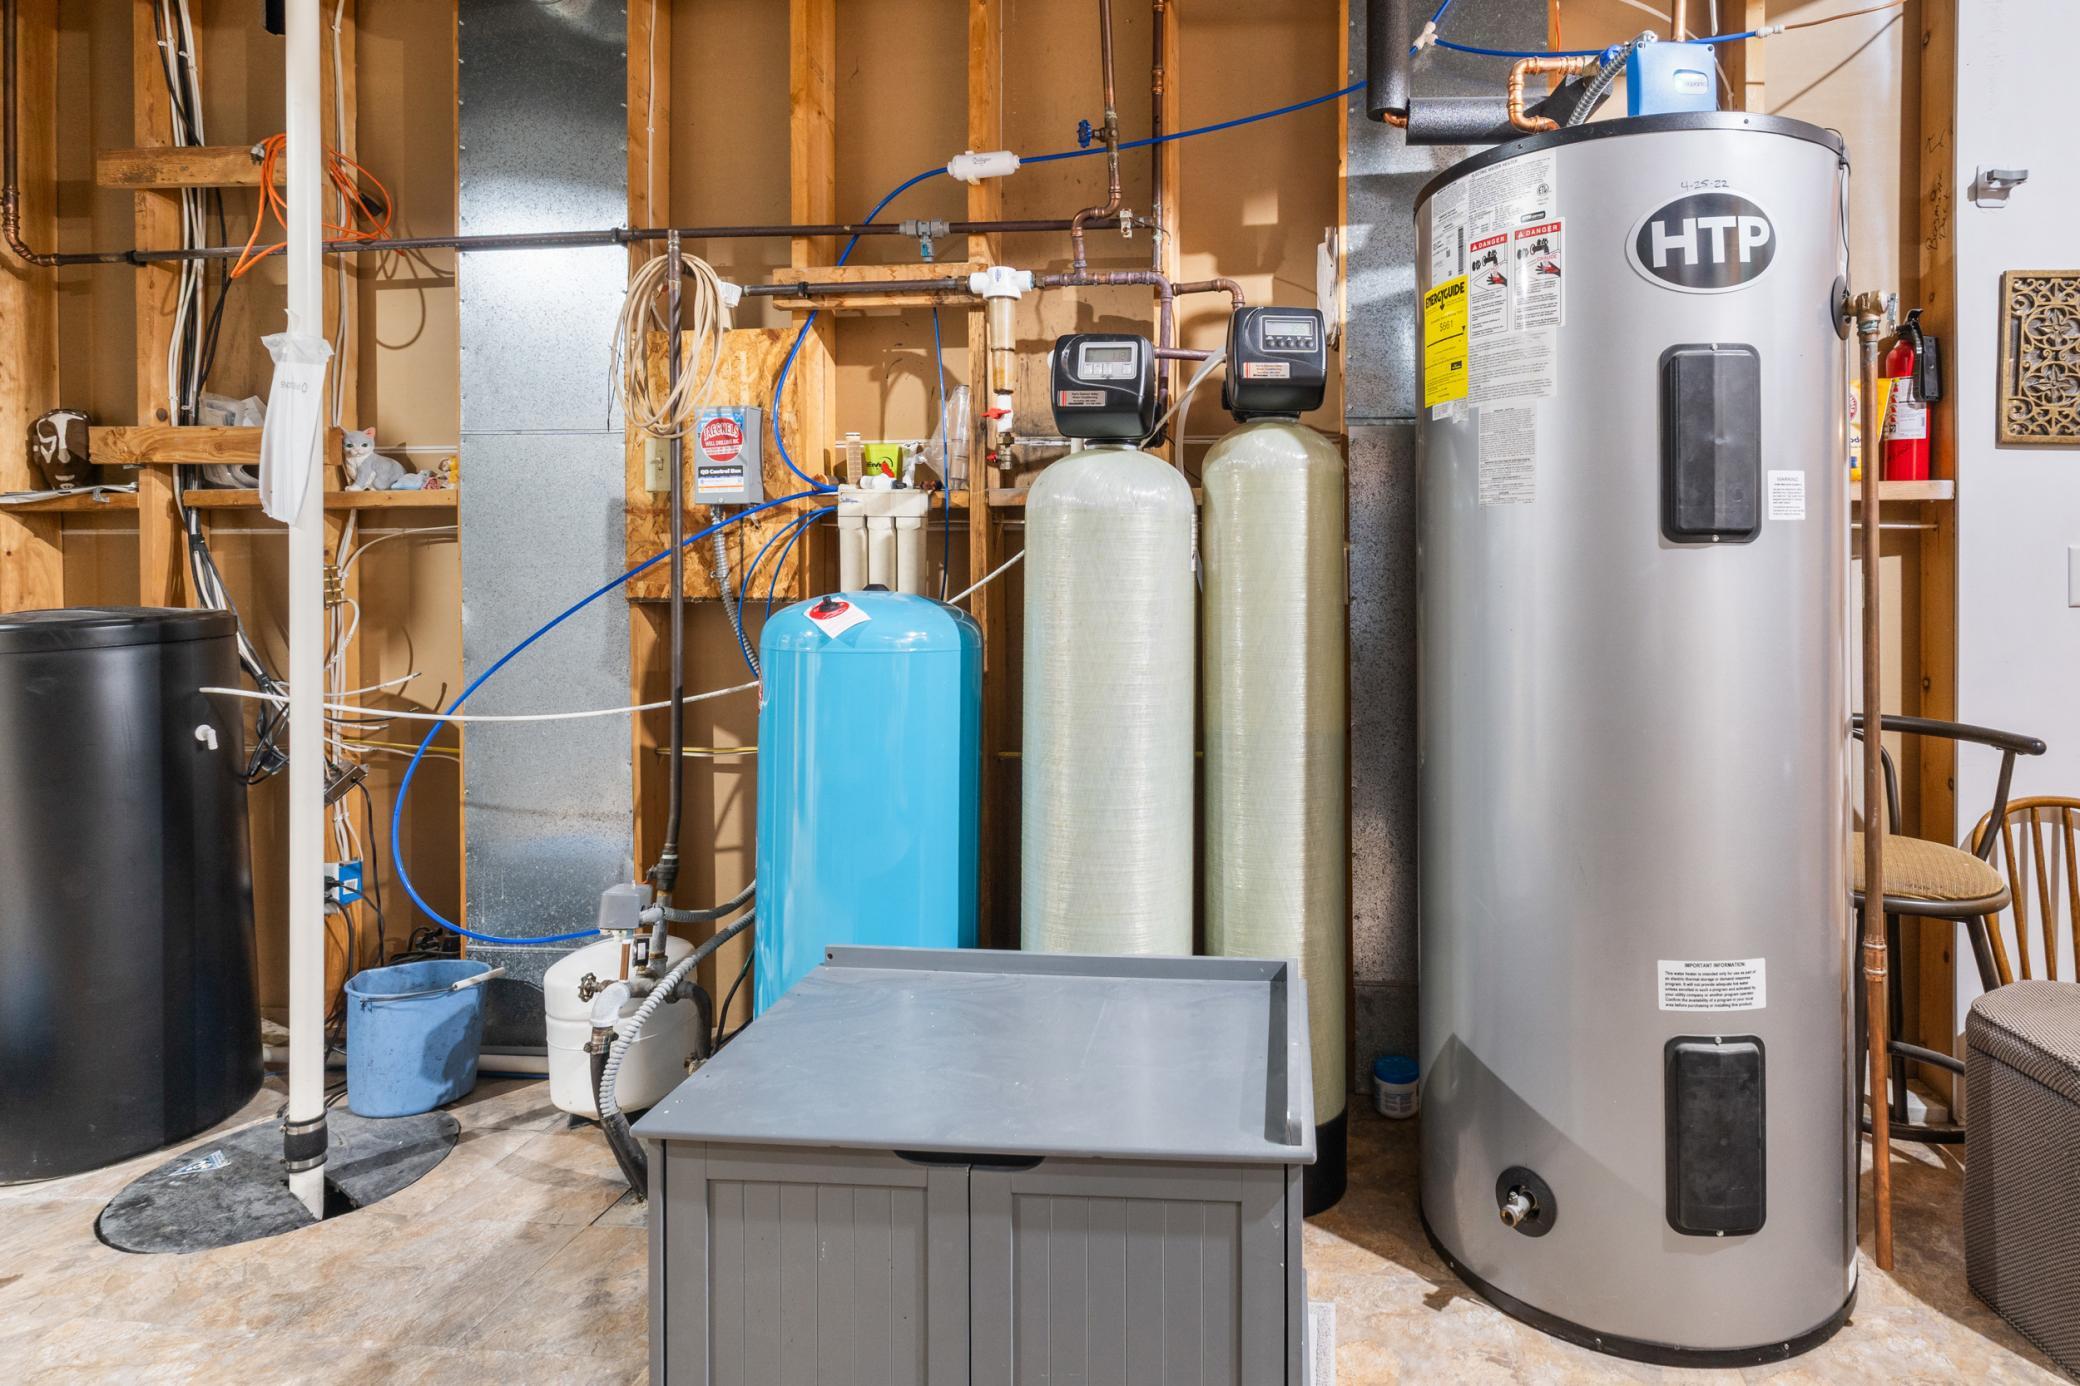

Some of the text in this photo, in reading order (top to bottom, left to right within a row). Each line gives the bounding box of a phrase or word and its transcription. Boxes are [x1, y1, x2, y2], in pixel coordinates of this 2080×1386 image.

[1526, 224, 1559, 236] DANGER
[1478, 235, 1506, 248] DANGER
[1651, 215, 1770, 268] HTP
[1425, 281, 1465, 310] ENERGYGUIDE
[709, 467, 730, 475] Control
